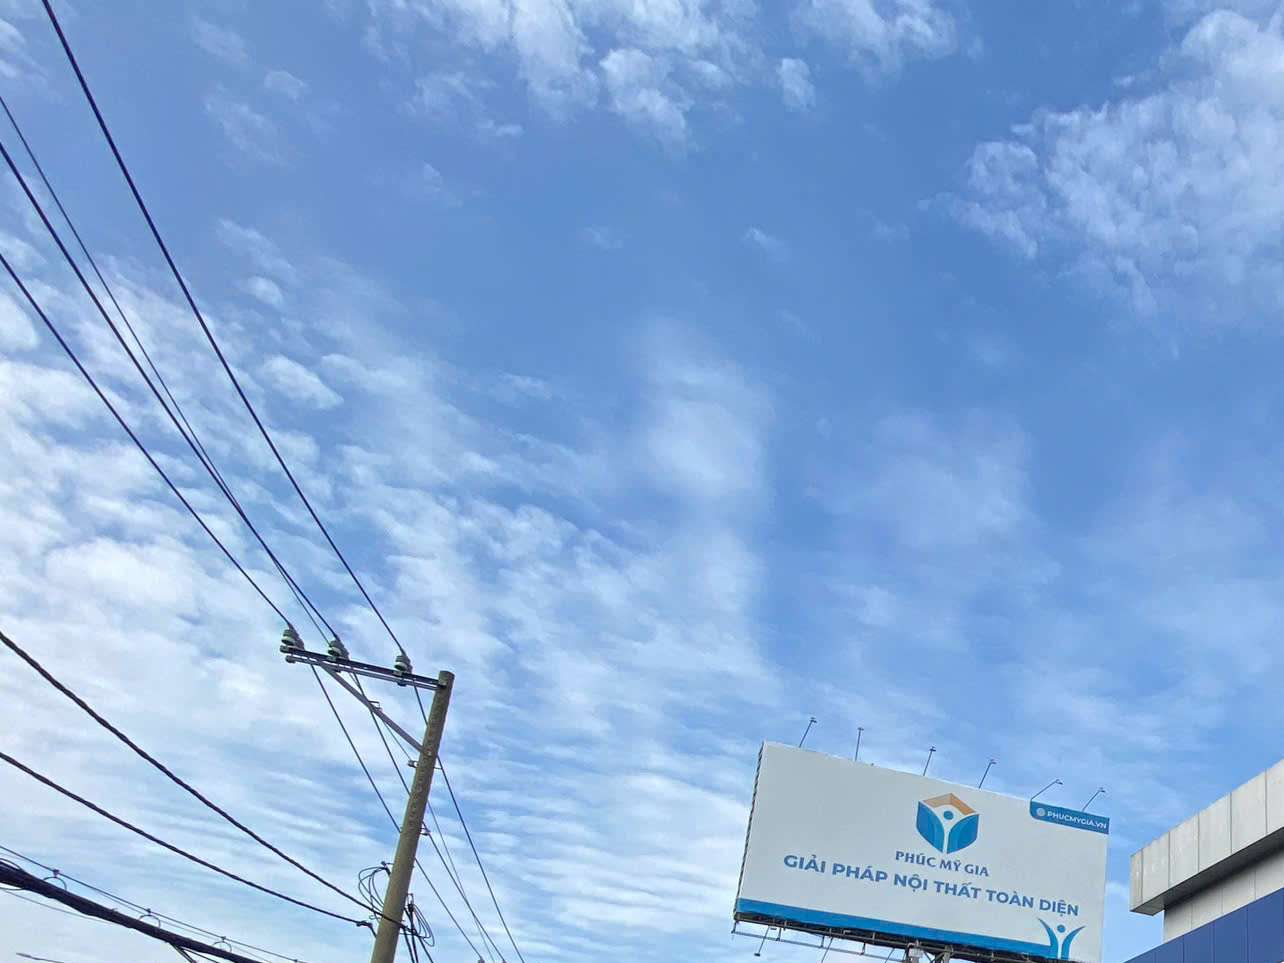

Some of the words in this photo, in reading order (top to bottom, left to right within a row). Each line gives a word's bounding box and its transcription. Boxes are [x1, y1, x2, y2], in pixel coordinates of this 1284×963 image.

[1047, 811, 1107, 829] PHUCMYGIA.VN
[895, 850, 937, 868] PHÚC
[939, 860, 962, 872] MỸ
[964, 863, 990, 877] GIA
[783, 854, 826, 873] GIẢI
[832, 863, 888, 882] PHÁP
[893, 873, 928, 892] NỘI
[933, 881, 981, 899] THẤT
[986, 889, 1034, 909] TOÀN
[1039, 899, 1079, 917] DIỆN
